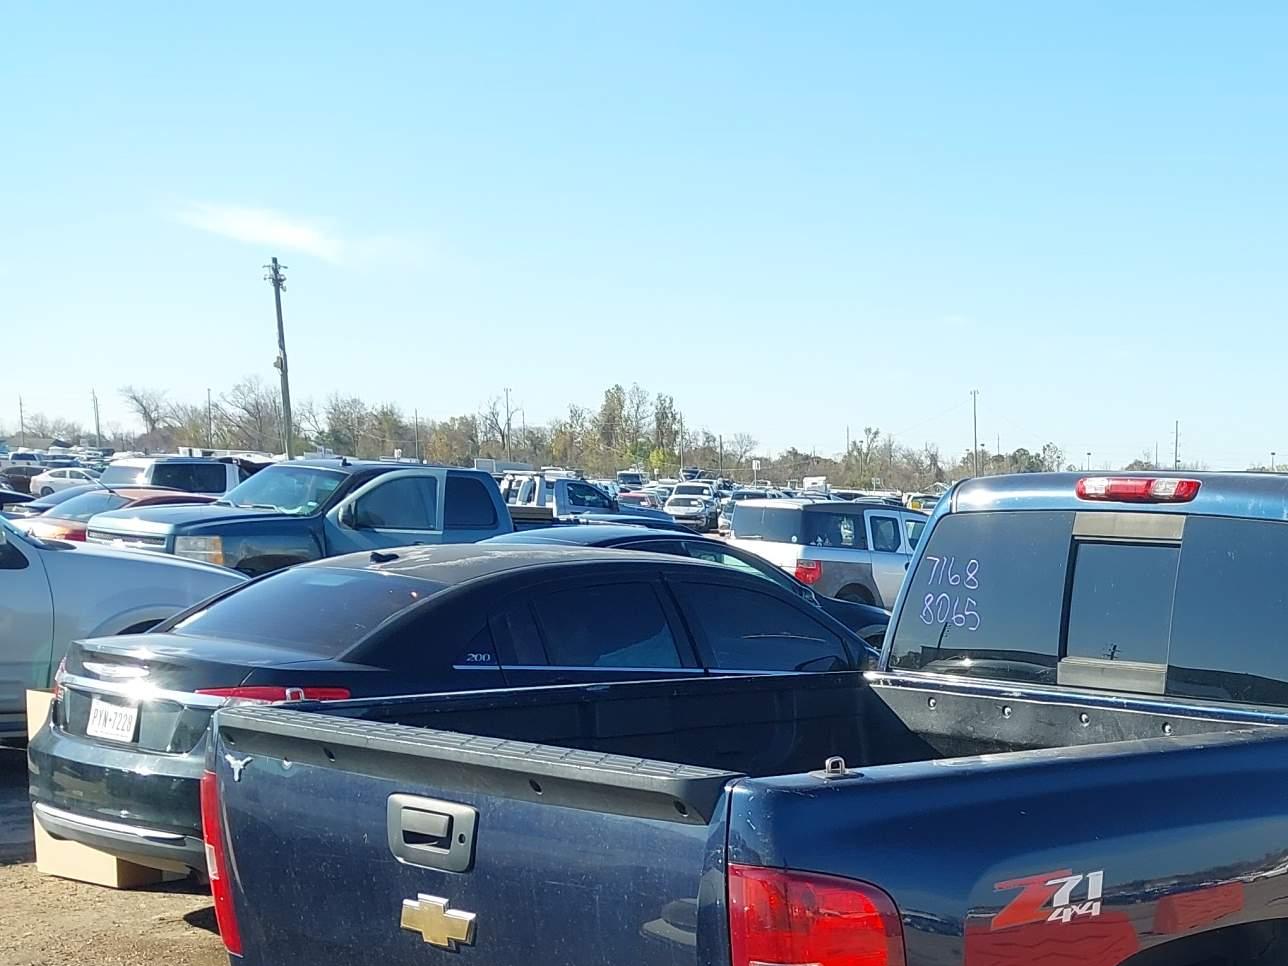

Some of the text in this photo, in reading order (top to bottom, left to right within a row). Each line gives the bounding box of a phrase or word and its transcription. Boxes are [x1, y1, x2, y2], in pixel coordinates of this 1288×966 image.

[926, 556, 979, 589] 7168
[920, 593, 980, 631] 8065
[466, 653, 490, 662] 200
